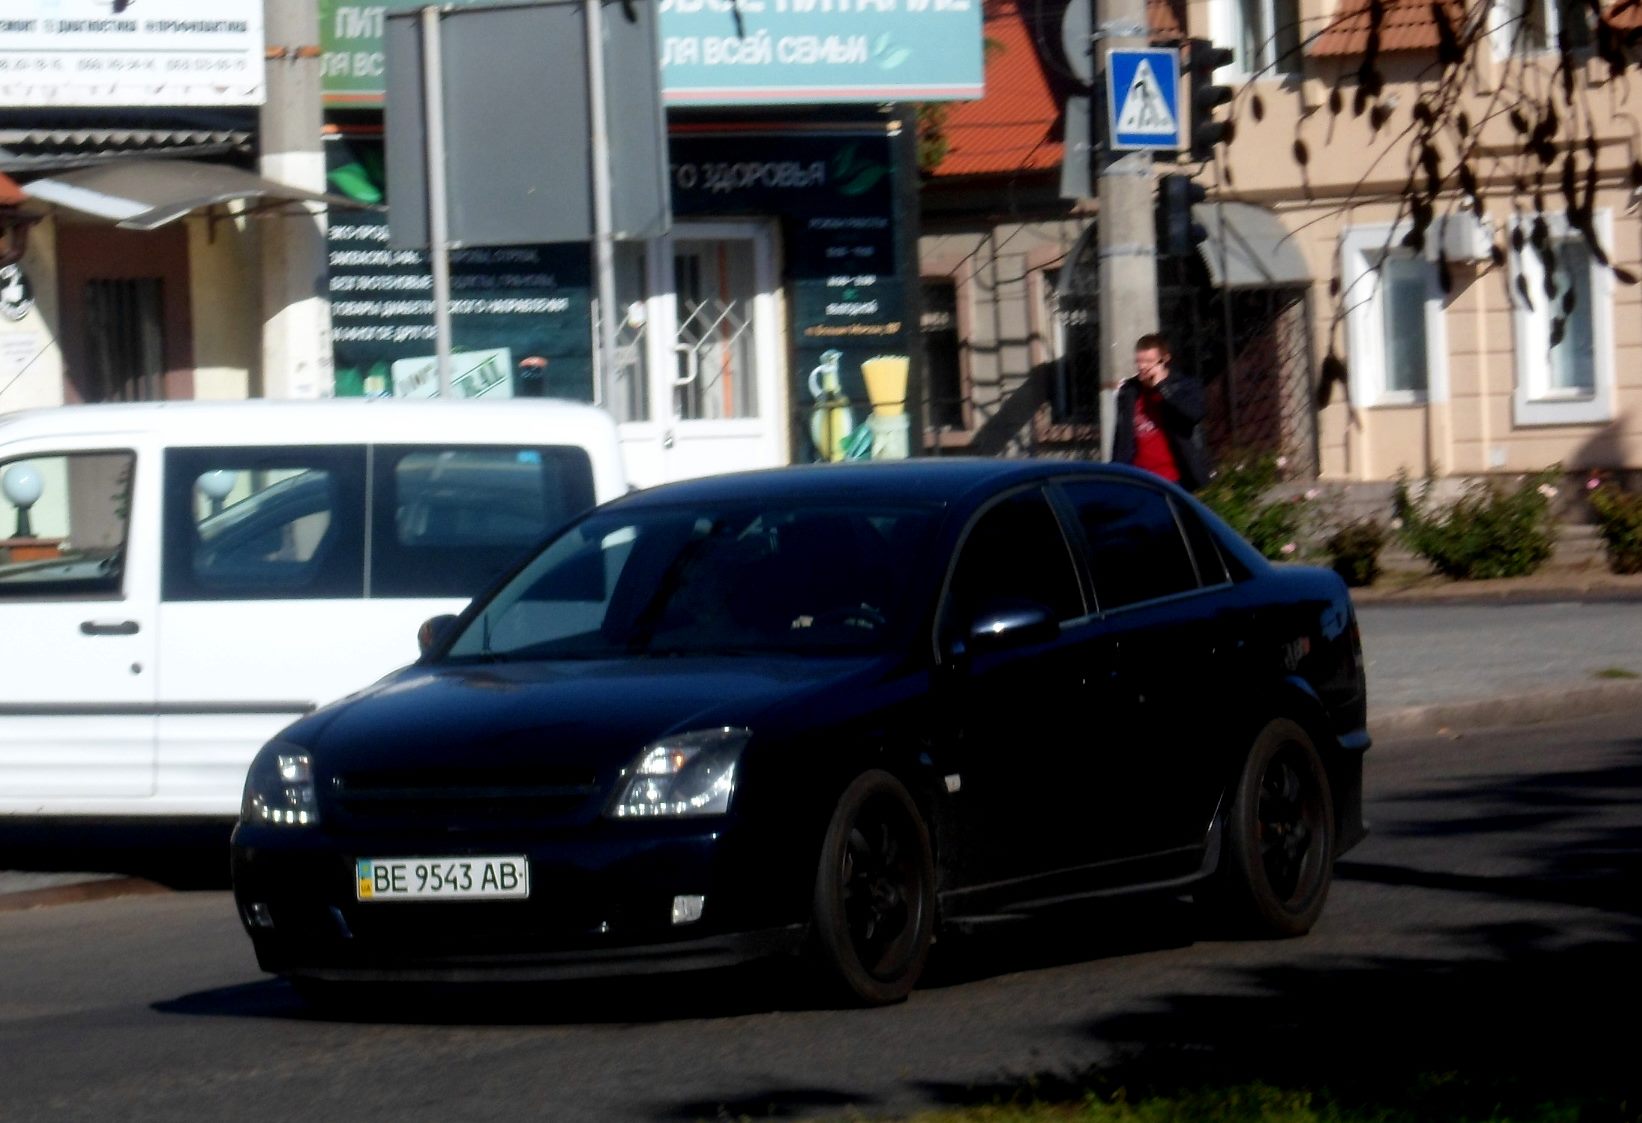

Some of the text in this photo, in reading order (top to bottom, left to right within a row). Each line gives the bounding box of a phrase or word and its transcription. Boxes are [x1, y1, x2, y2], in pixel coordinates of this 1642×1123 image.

[703, 29, 772, 64] ВСЕЙ
[777, 36, 867, 64] СЕМЬИ
[701, 160, 826, 194] ЗДОРОВЬЯ
[374, 862, 518, 892] BE 9543 AB
